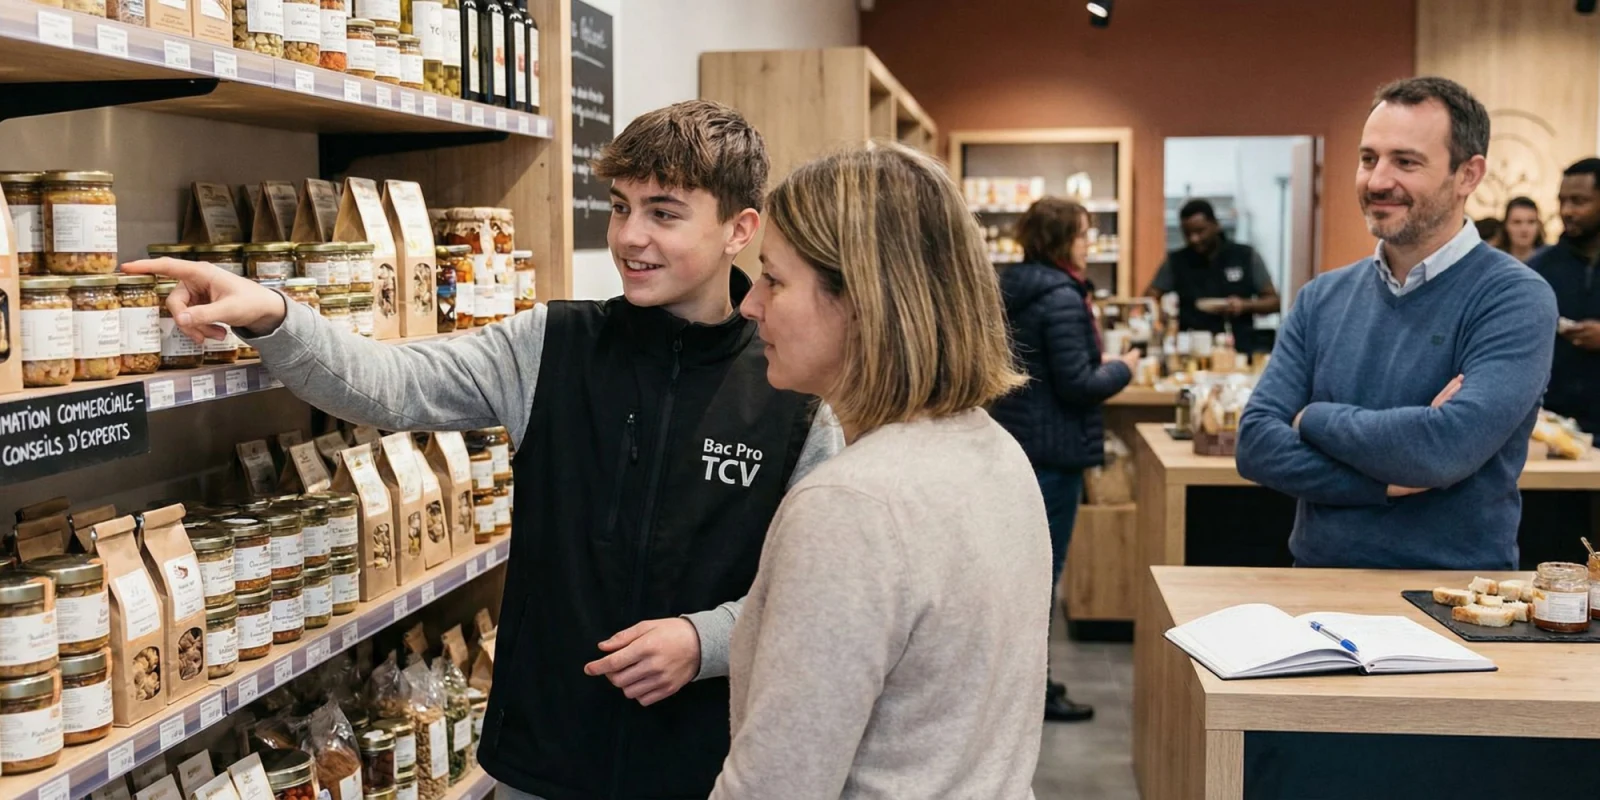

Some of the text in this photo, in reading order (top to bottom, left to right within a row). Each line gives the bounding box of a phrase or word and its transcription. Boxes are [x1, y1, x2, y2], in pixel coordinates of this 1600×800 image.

[67, 422, 131, 453] D'EXPERTS
[703, 438, 763, 461] Bac Pro
[701, 455, 761, 487] TCV
